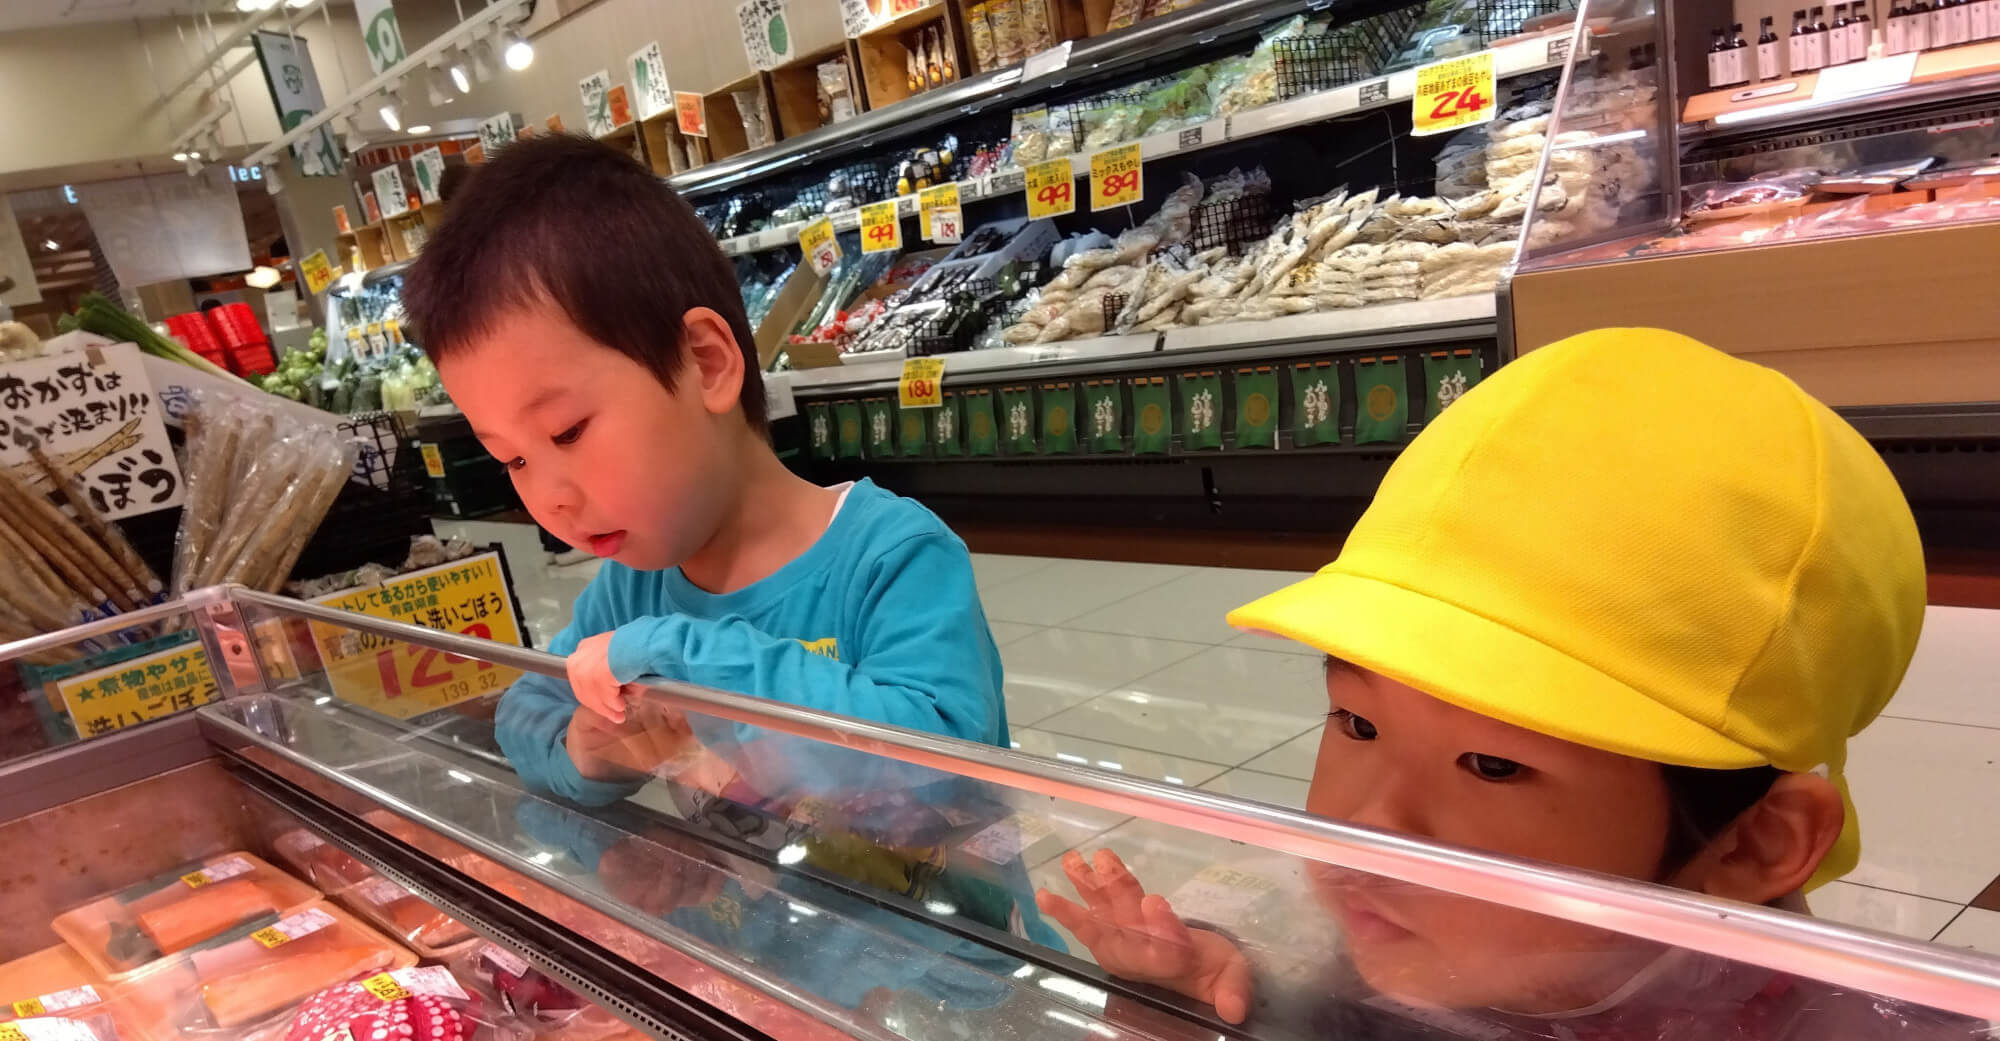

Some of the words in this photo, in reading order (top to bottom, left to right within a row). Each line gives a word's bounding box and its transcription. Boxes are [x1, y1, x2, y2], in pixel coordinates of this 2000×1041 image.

[1430, 85, 1487, 119] 24
[1037, 182, 1071, 206] 99
[1102, 169, 1139, 198] 89
[869, 223, 895, 243] 99
[0, 364, 121, 410] おかずは
[339, 561, 493, 611] トしてあるから使いやすい!
[442, 681, 469, 701] 139
[480, 672, 498, 691] 32
